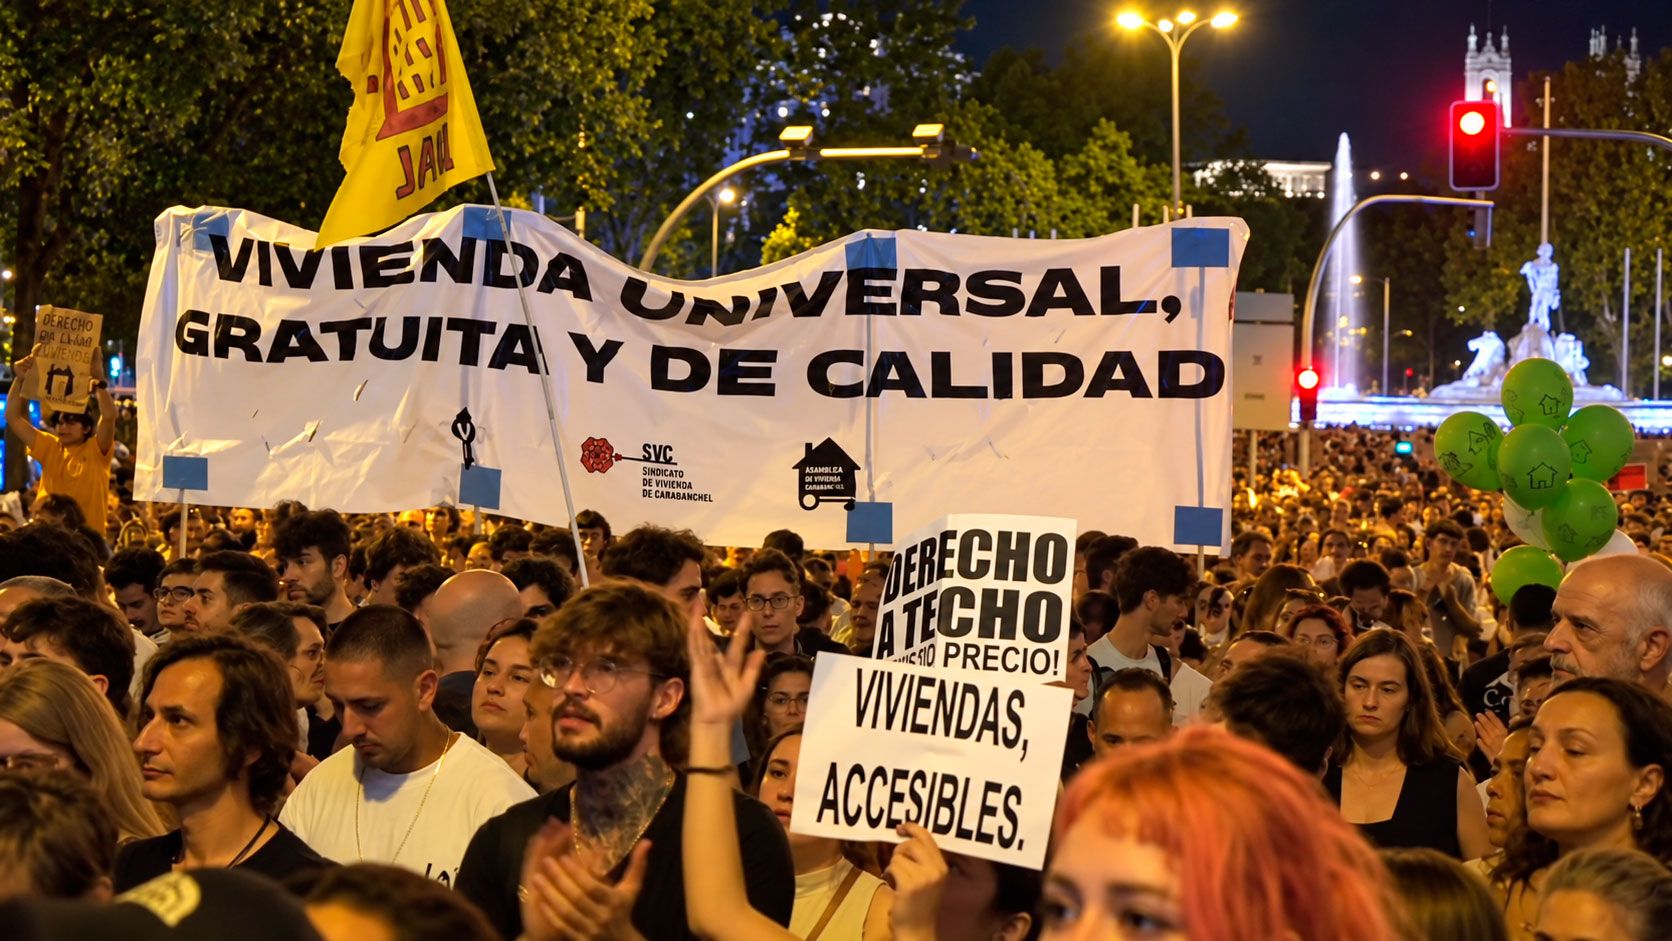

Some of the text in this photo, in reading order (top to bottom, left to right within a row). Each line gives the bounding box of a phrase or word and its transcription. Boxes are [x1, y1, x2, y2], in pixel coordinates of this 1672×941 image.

[208, 233, 1182, 326] VIVIENDA UNIVERSAL,
[42, 313, 94, 332] DERECHO
[175, 309, 1225, 400] GRATUITA Y DE CALIDAD
[642, 443, 674, 463] SVC
[642, 466, 684, 478] SINDICATO
[642, 478, 693, 490] DE VIVIENDA
[642, 489, 714, 503] DE CARABANCHEL
[883, 528, 1069, 606] DERECHO
[876, 609, 895, 660] A
[902, 585, 1063, 651] TECHO
[943, 642, 1060, 676] PRECIO!
[855, 667, 1029, 763] VIVIENDAS,
[816, 761, 1025, 852] ACCESIBLES.
